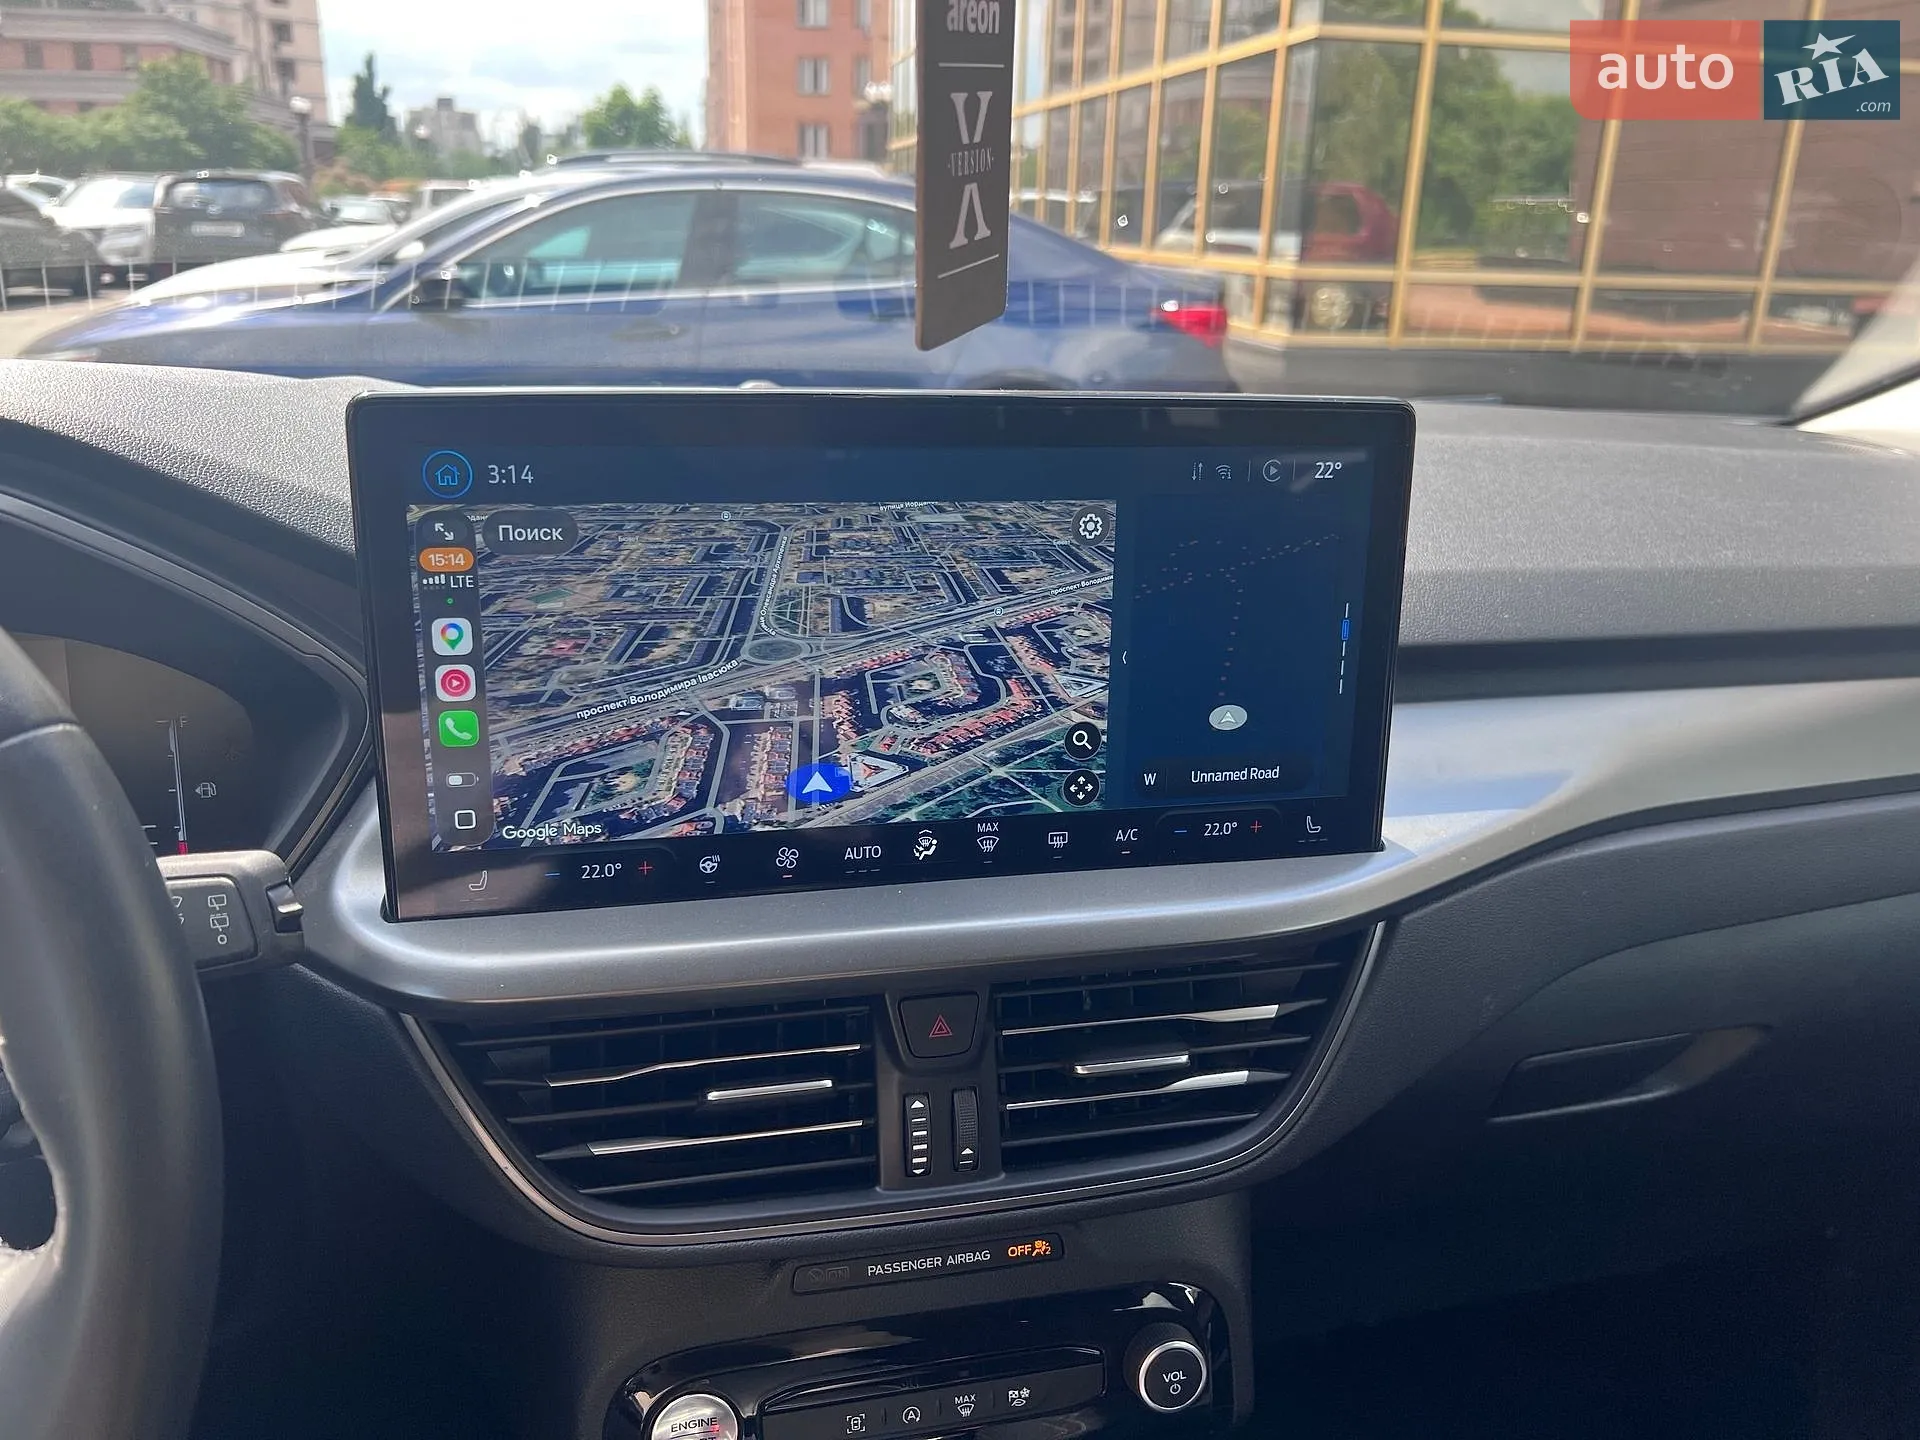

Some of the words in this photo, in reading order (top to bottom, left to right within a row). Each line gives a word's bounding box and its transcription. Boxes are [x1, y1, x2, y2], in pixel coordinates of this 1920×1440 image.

[946, 0, 1000, 34] areon
[488, 465, 534, 484] 3:14
[1314, 462, 1342, 479] 22°
[498, 524, 564, 542] Поиск
[428, 553, 466, 567] 15:14
[450, 575, 475, 588] LTE
[1050, 583, 1081, 596] проспект
[576, 699, 628, 720] проспект
[629, 678, 698, 706] Володимира
[698, 658, 739, 684] Івасюка
[1143, 772, 1157, 786] W
[1191, 767, 1248, 783] Unnamed
[1249, 766, 1280, 780] Road
[502, 823, 558, 841] Google
[563, 822, 602, 838] Maps
[977, 821, 999, 833] MAX
[1115, 828, 1139, 842] A/C
[1203, 821, 1238, 837] 22.0°
[844, 845, 882, 861] AUTO
[581, 862, 622, 880] 22.0°
[1007, 1244, 1032, 1257] OFF
[867, 1256, 942, 1277] PASSENGER
[946, 1250, 991, 1266] AIRBAG
[1162, 1370, 1187, 1383] VOL
[954, 1393, 977, 1405] MAX
[670, 1417, 718, 1433] ENGINE
